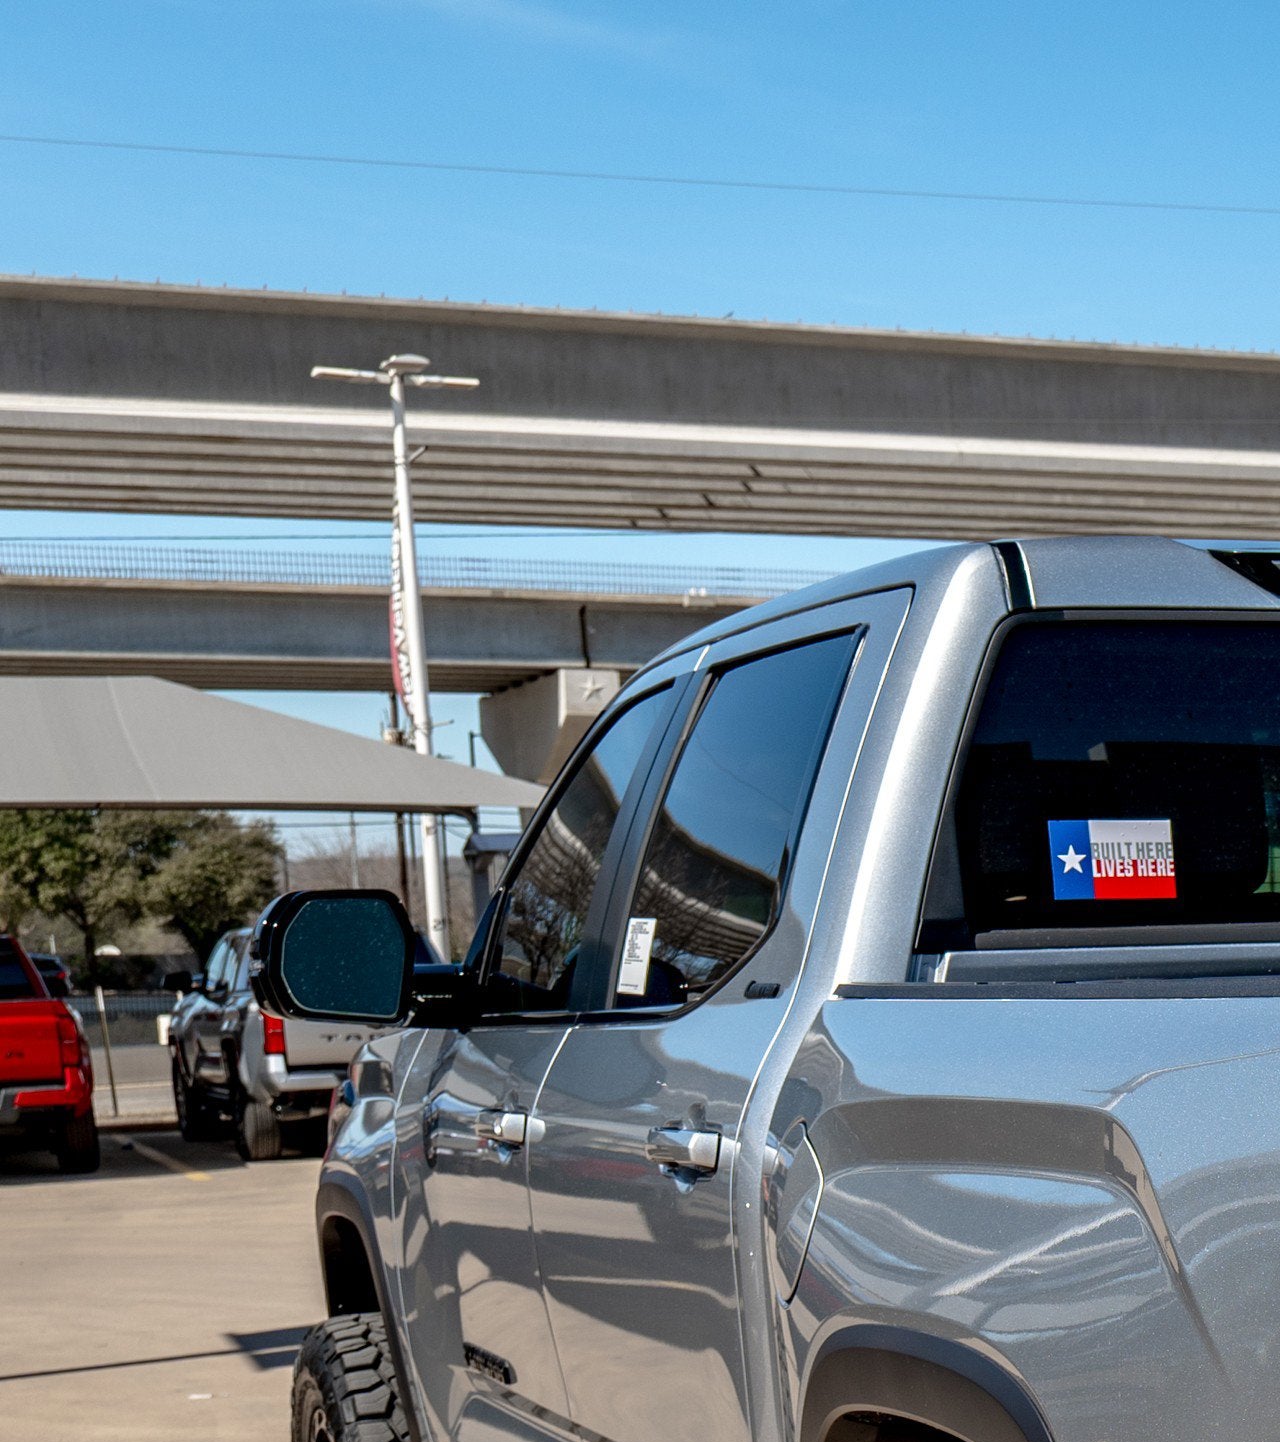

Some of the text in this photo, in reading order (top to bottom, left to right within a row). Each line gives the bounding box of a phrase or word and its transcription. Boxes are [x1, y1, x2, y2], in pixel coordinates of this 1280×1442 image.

[1092, 842, 1174, 859] BUILT HERE
[1092, 860, 1175, 878] LIVES HERE
